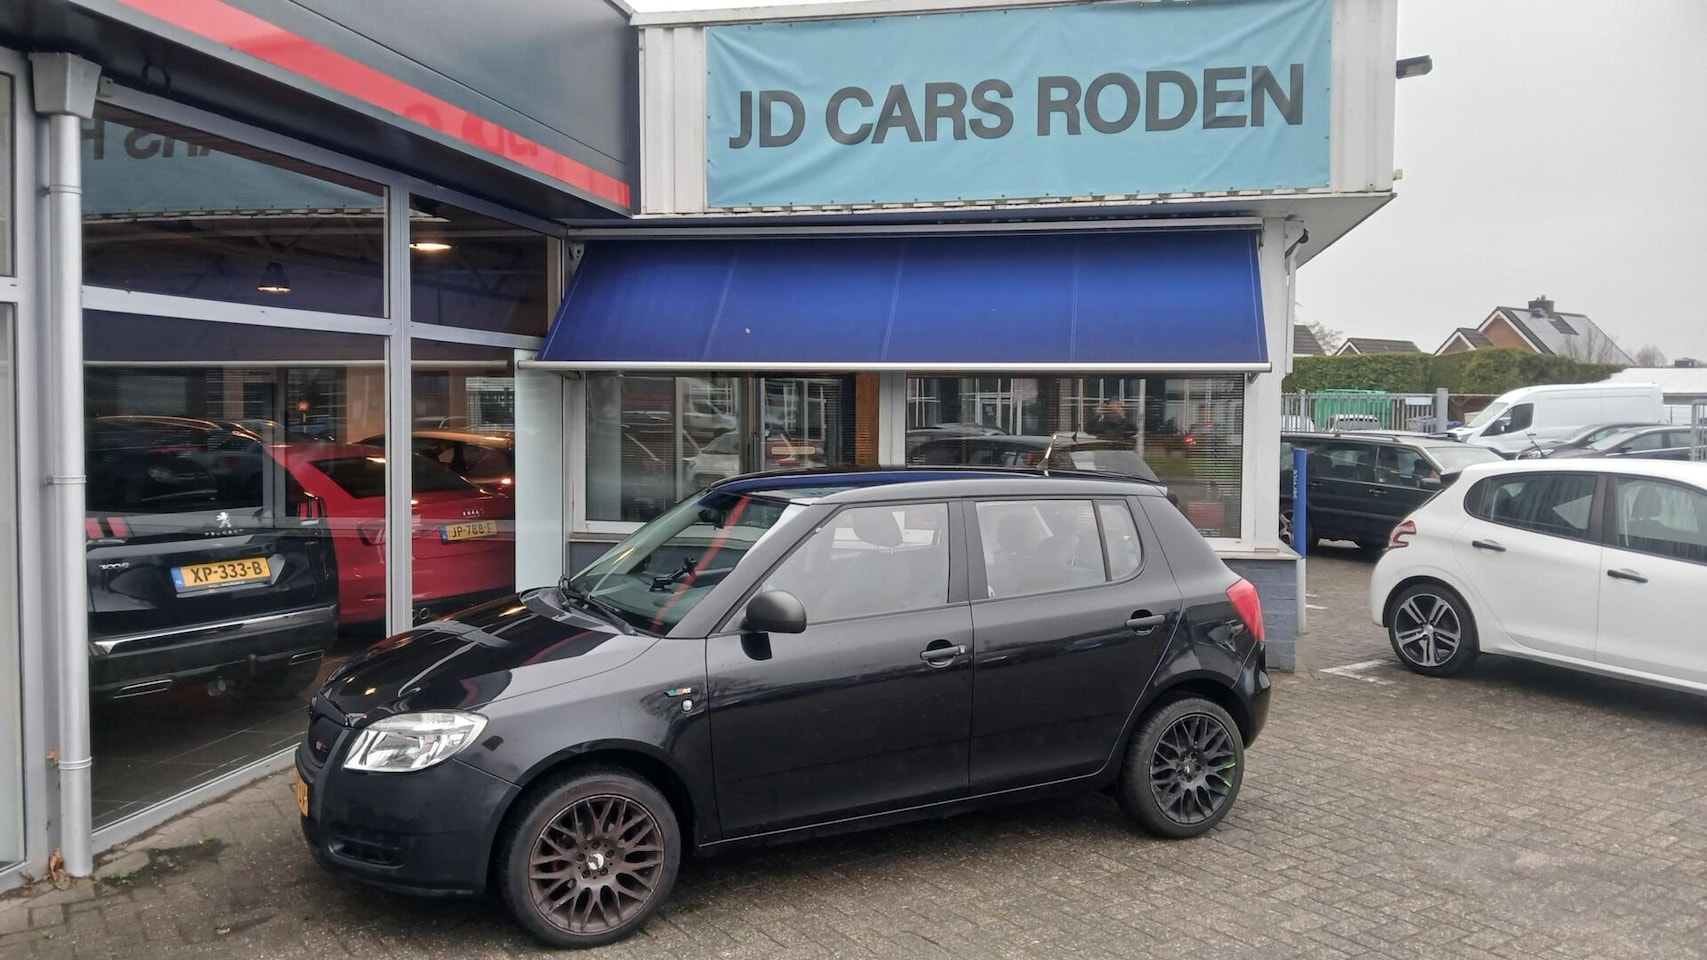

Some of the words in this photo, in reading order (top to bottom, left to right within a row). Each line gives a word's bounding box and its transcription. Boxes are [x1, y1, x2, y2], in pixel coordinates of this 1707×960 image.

[729, 90, 806, 149] JD
[825, 79, 1014, 145] CARS
[1036, 63, 1305, 137] RODEN
[190, 560, 263, 584] XP-333-B
